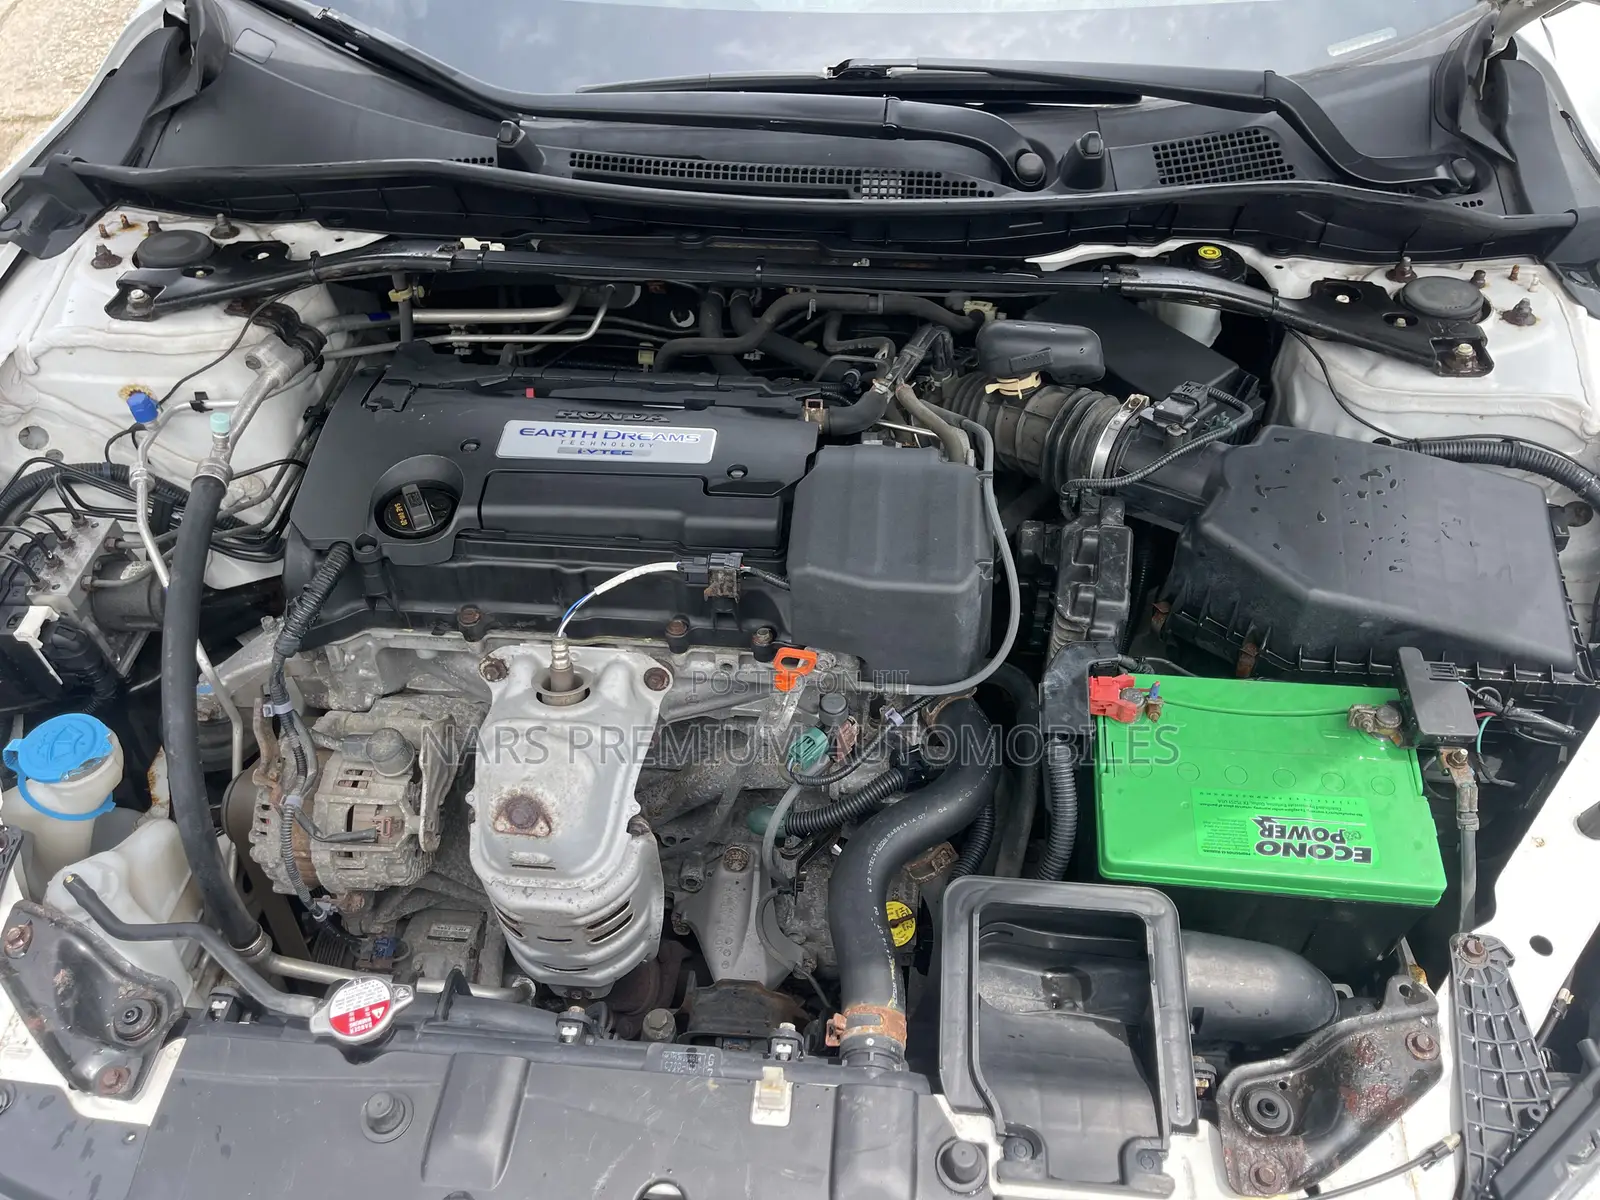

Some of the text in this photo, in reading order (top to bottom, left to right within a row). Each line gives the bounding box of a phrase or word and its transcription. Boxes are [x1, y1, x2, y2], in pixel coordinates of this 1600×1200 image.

[555, 410, 670, 423] HONDA
[519, 427, 597, 439] EARTH
[561, 439, 654, 448] TECHNOLOGY
[1257, 821, 1347, 845] POWER
[1254, 839, 1372, 864] ECONO
